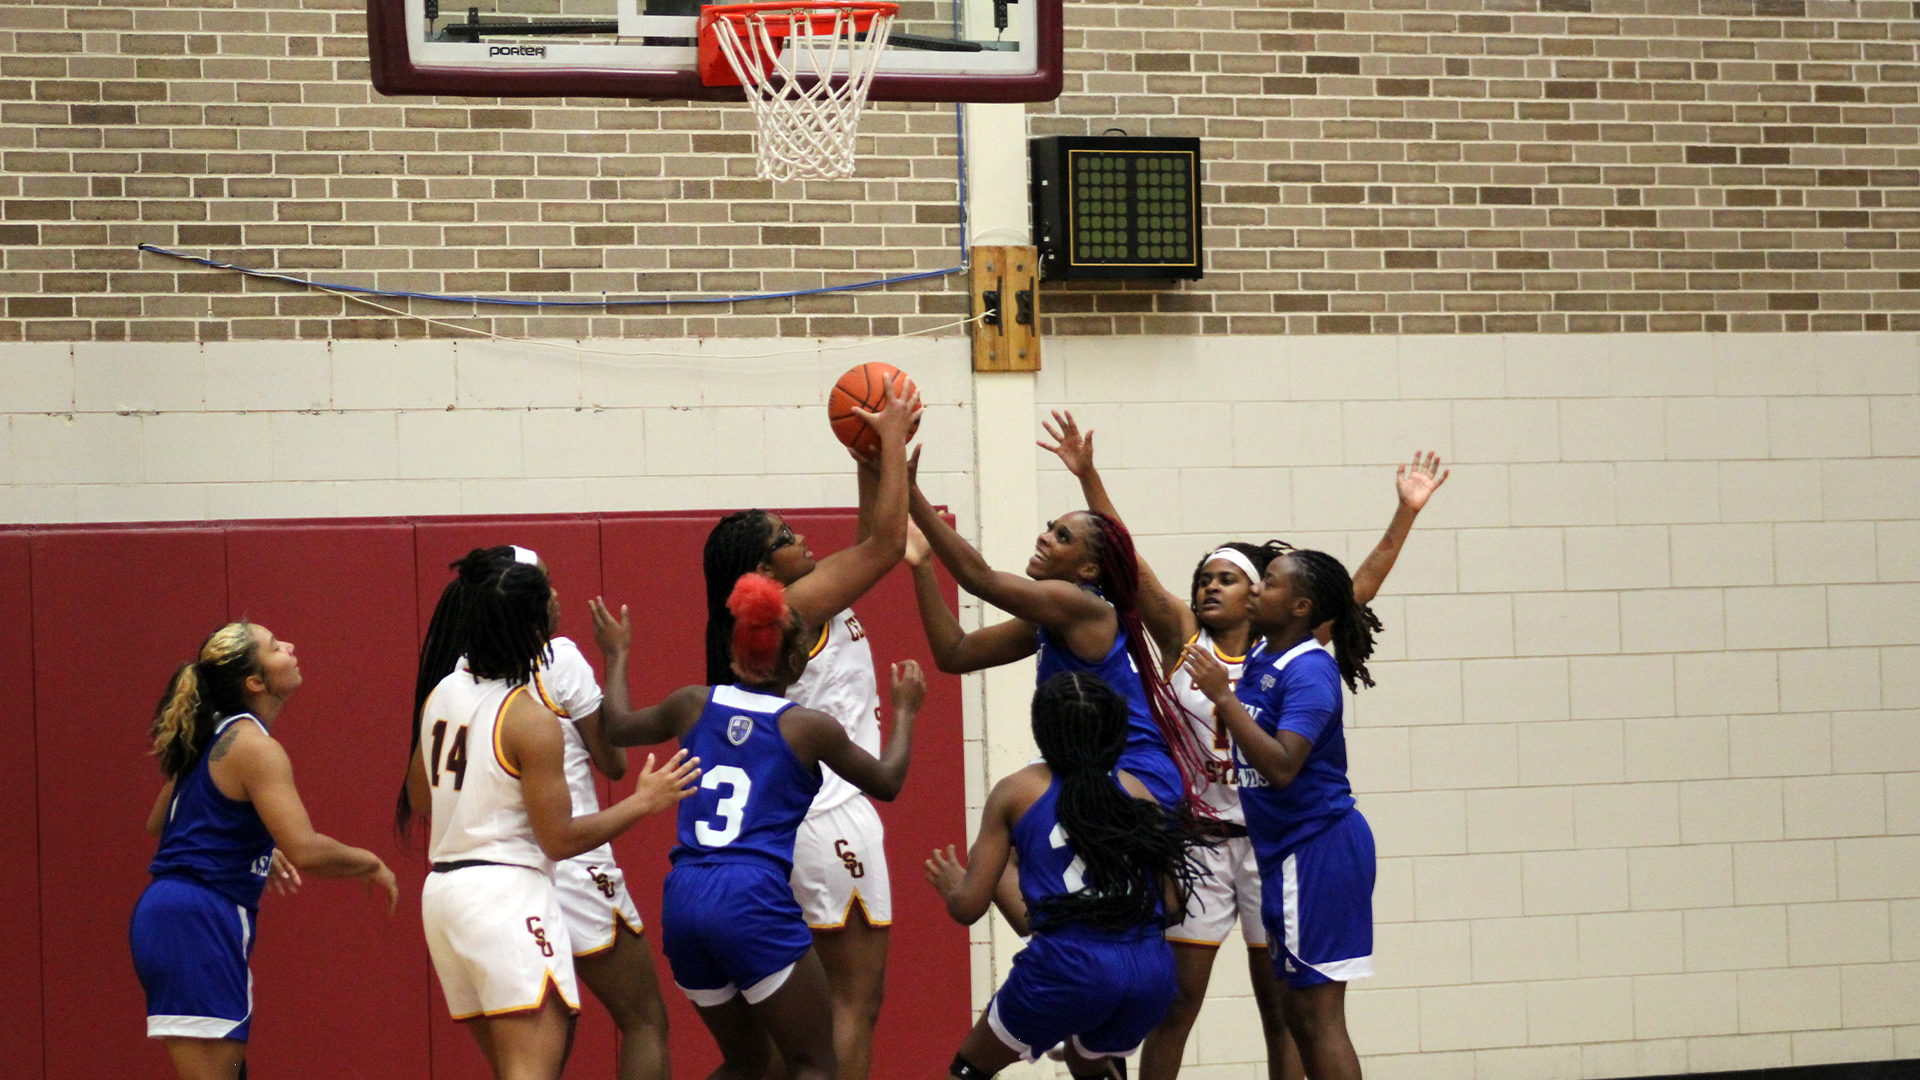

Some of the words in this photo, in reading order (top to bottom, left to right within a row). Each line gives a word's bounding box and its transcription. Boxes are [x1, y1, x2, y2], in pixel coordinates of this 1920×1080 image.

[431, 720, 469, 792] 14
[695, 765, 751, 847] 3
[834, 839, 864, 879] CSU
[586, 866, 615, 898] CSU
[526, 916, 554, 957] CSU
